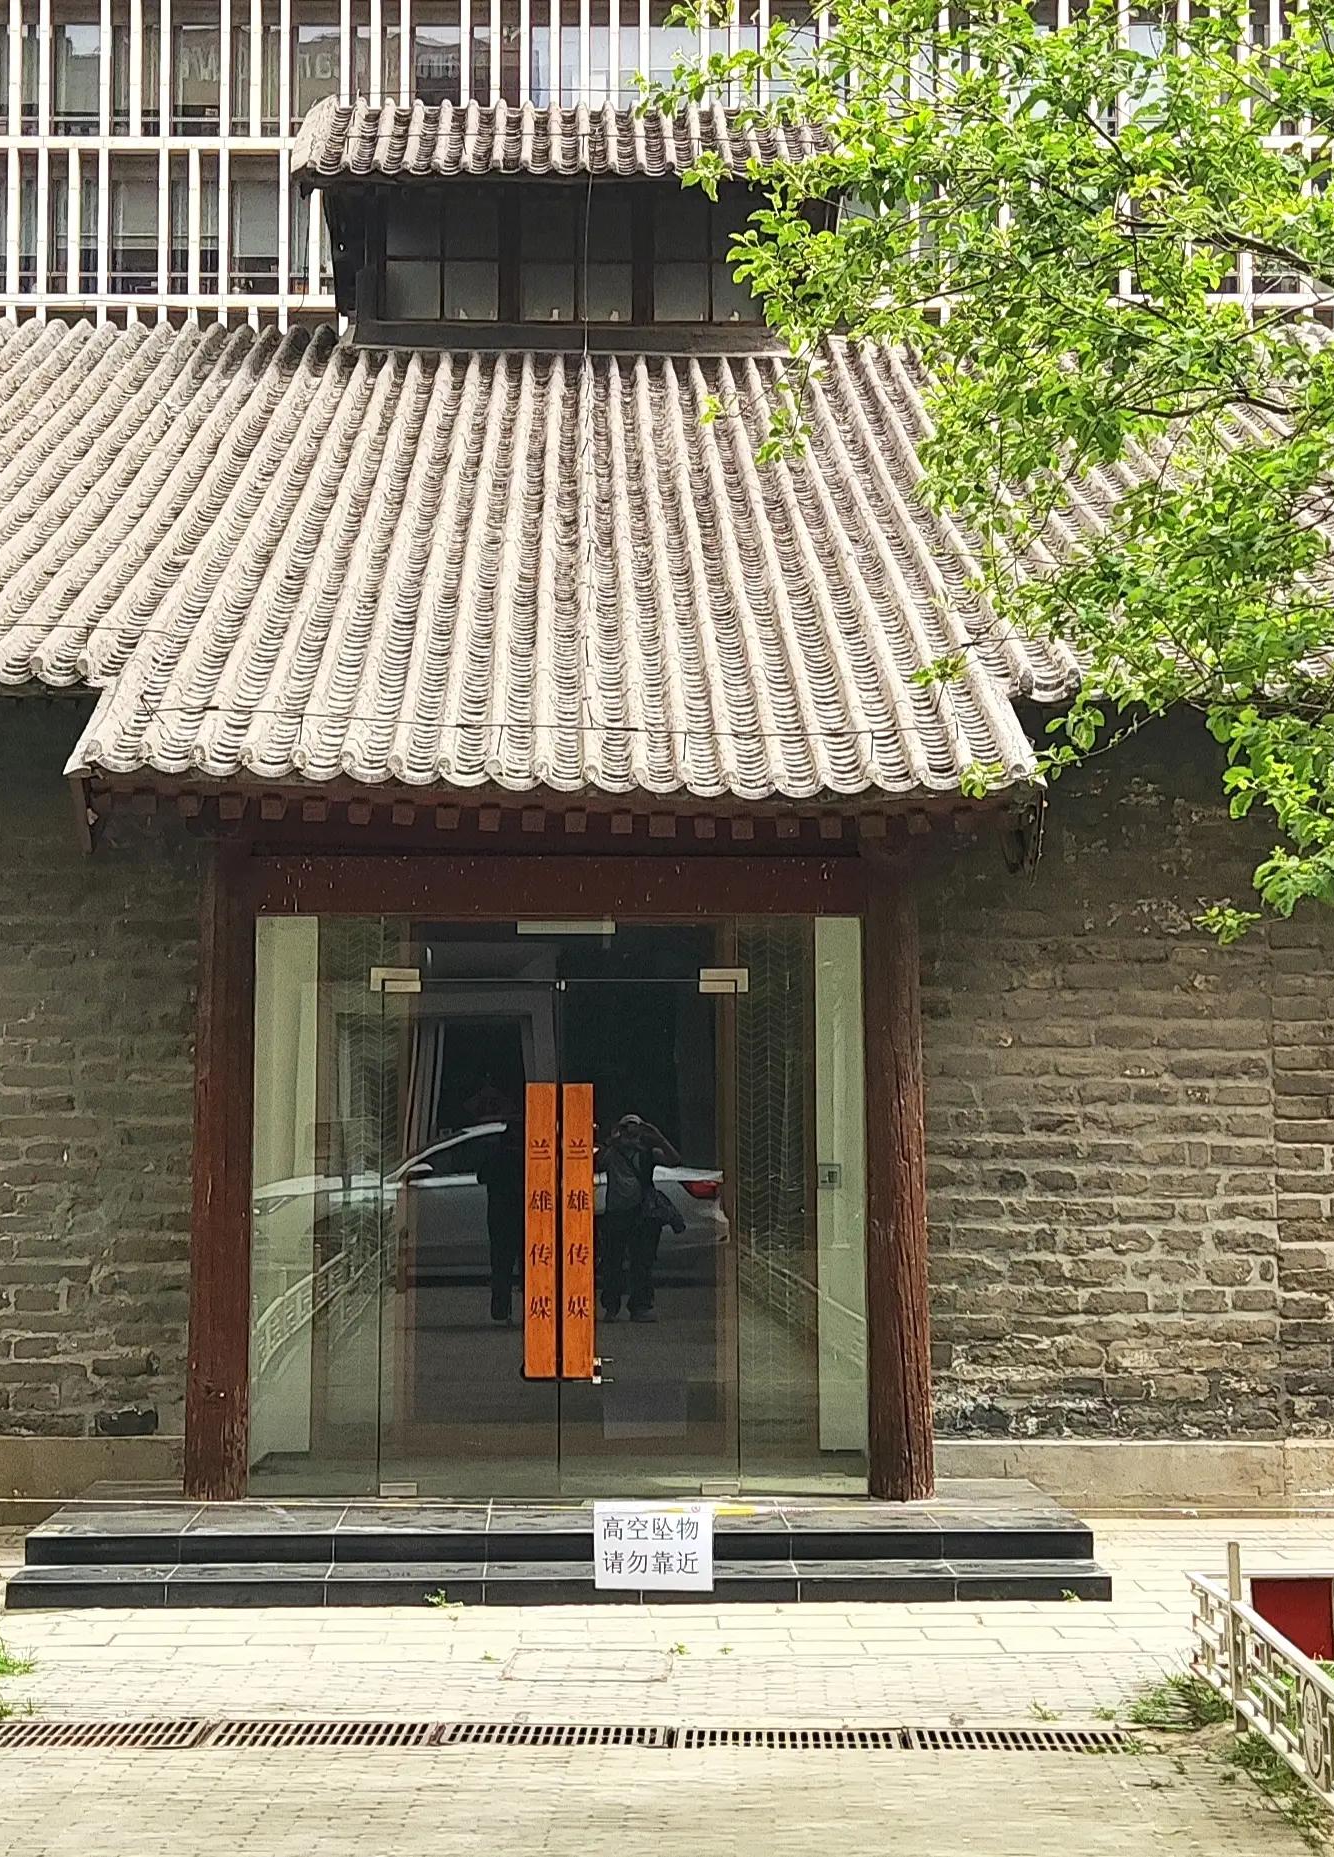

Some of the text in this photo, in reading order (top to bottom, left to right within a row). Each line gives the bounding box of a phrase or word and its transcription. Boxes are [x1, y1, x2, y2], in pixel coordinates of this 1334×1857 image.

[529, 1137, 553, 1320] 兰雄传媒
[566, 1137, 590, 1320] 兰雄传媒
[601, 1515, 700, 1542] 高空坠物
[601, 1549, 701, 1575] 请勿靠近
